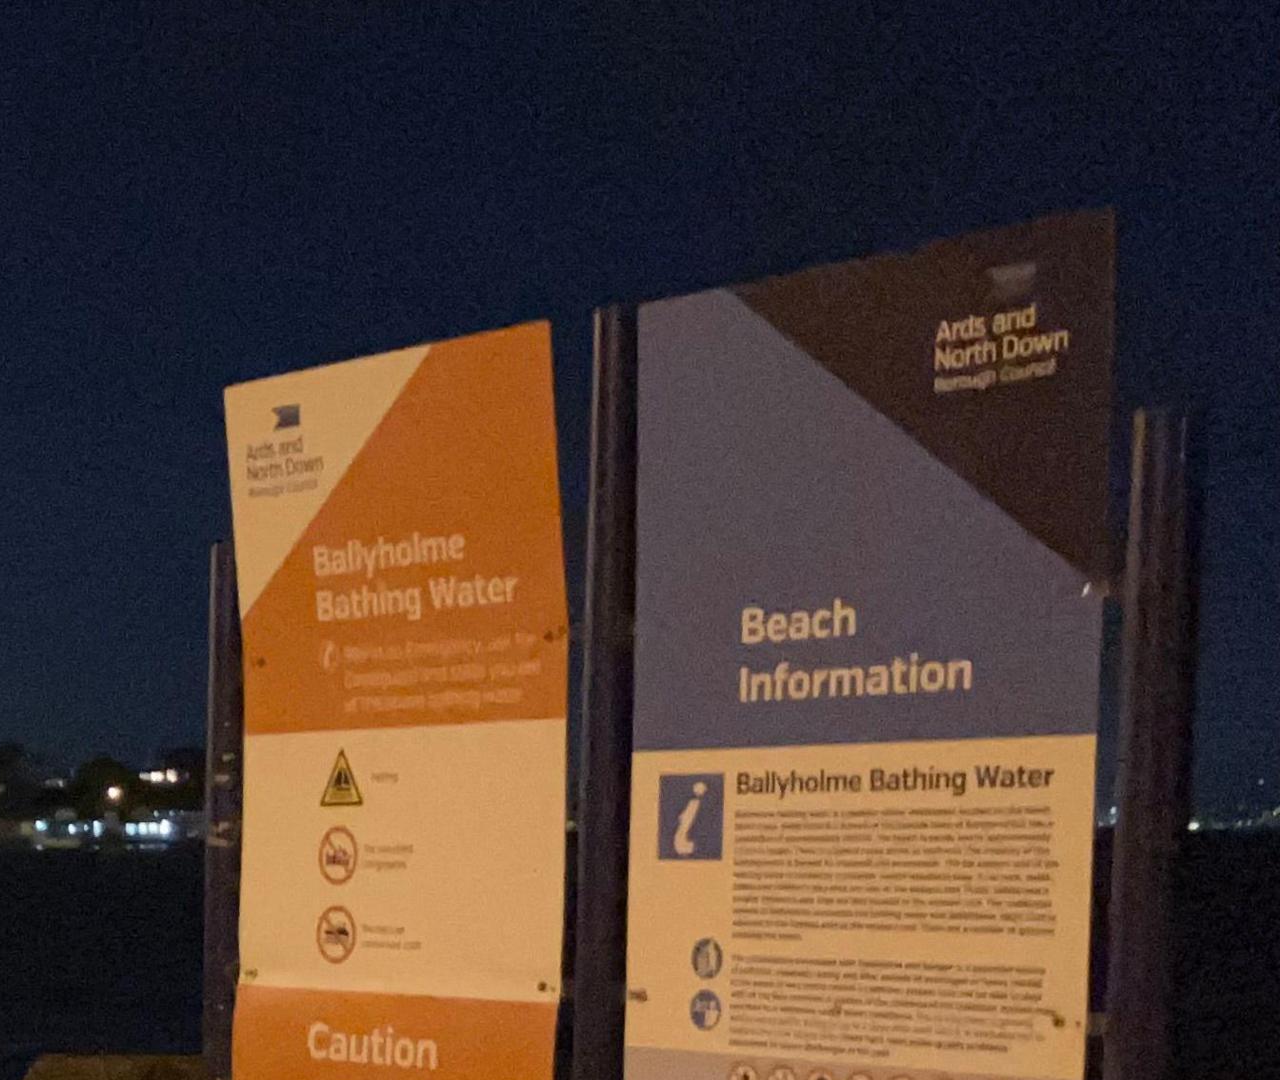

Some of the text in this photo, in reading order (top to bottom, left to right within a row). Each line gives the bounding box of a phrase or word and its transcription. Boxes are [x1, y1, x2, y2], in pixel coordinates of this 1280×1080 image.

[936, 302, 1037, 342] Ards and
[934, 329, 1070, 371] North Down
[247, 455, 325, 481] North Down
[278, 435, 304, 456] and
[312, 531, 466, 579] Ballyholme
[314, 573, 519, 622] Bathing Water
[740, 596, 858, 645] Beach
[739, 652, 973, 703] Information
[735, 764, 1055, 800] Ballyholme Bathing Water
[307, 1021, 439, 1071] Caution
